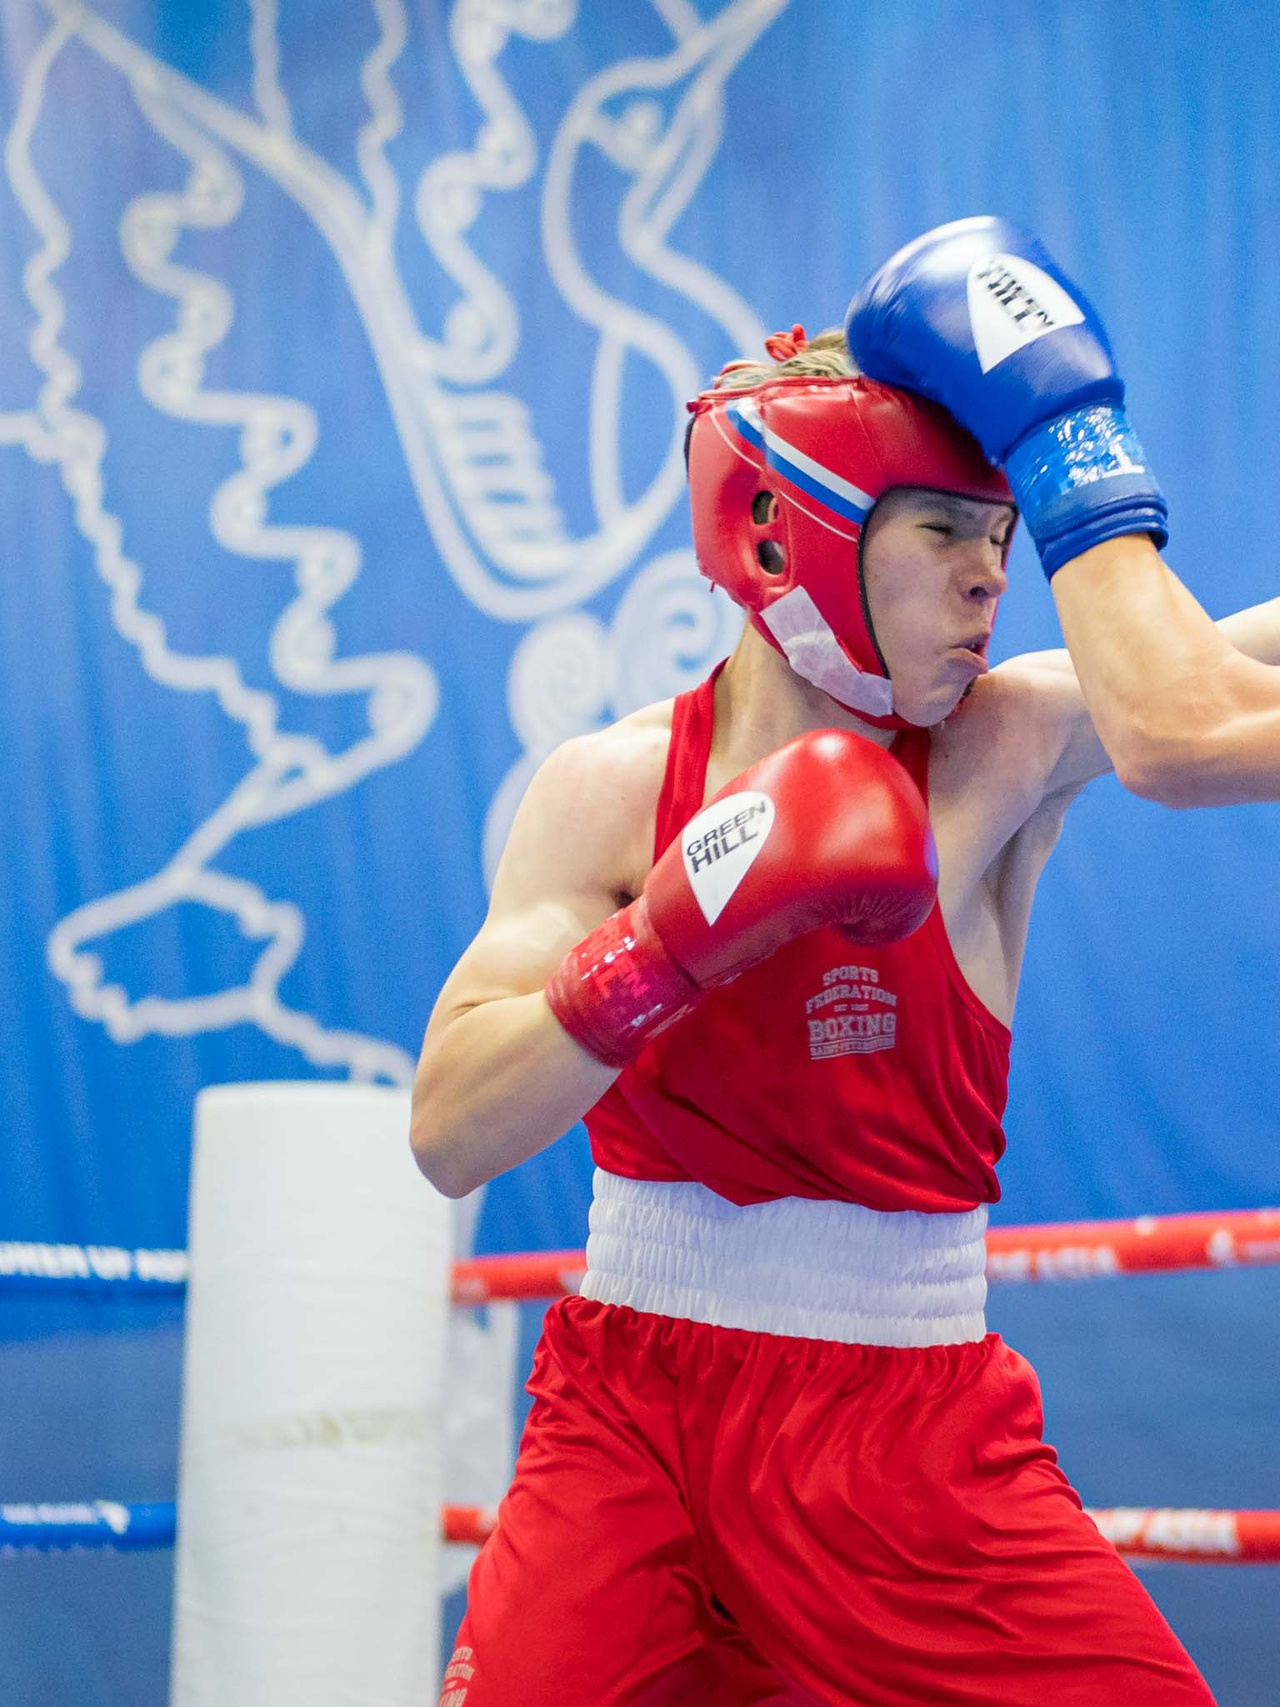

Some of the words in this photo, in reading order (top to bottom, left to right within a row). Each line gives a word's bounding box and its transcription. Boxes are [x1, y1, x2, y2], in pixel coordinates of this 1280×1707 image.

[687, 801, 766, 857] GREEN
[691, 826, 759, 874] HILL
[823, 966, 880, 986] SPORTS
[805, 985, 897, 1014] FEDERATION
[808, 1012, 897, 1043] BOXING
